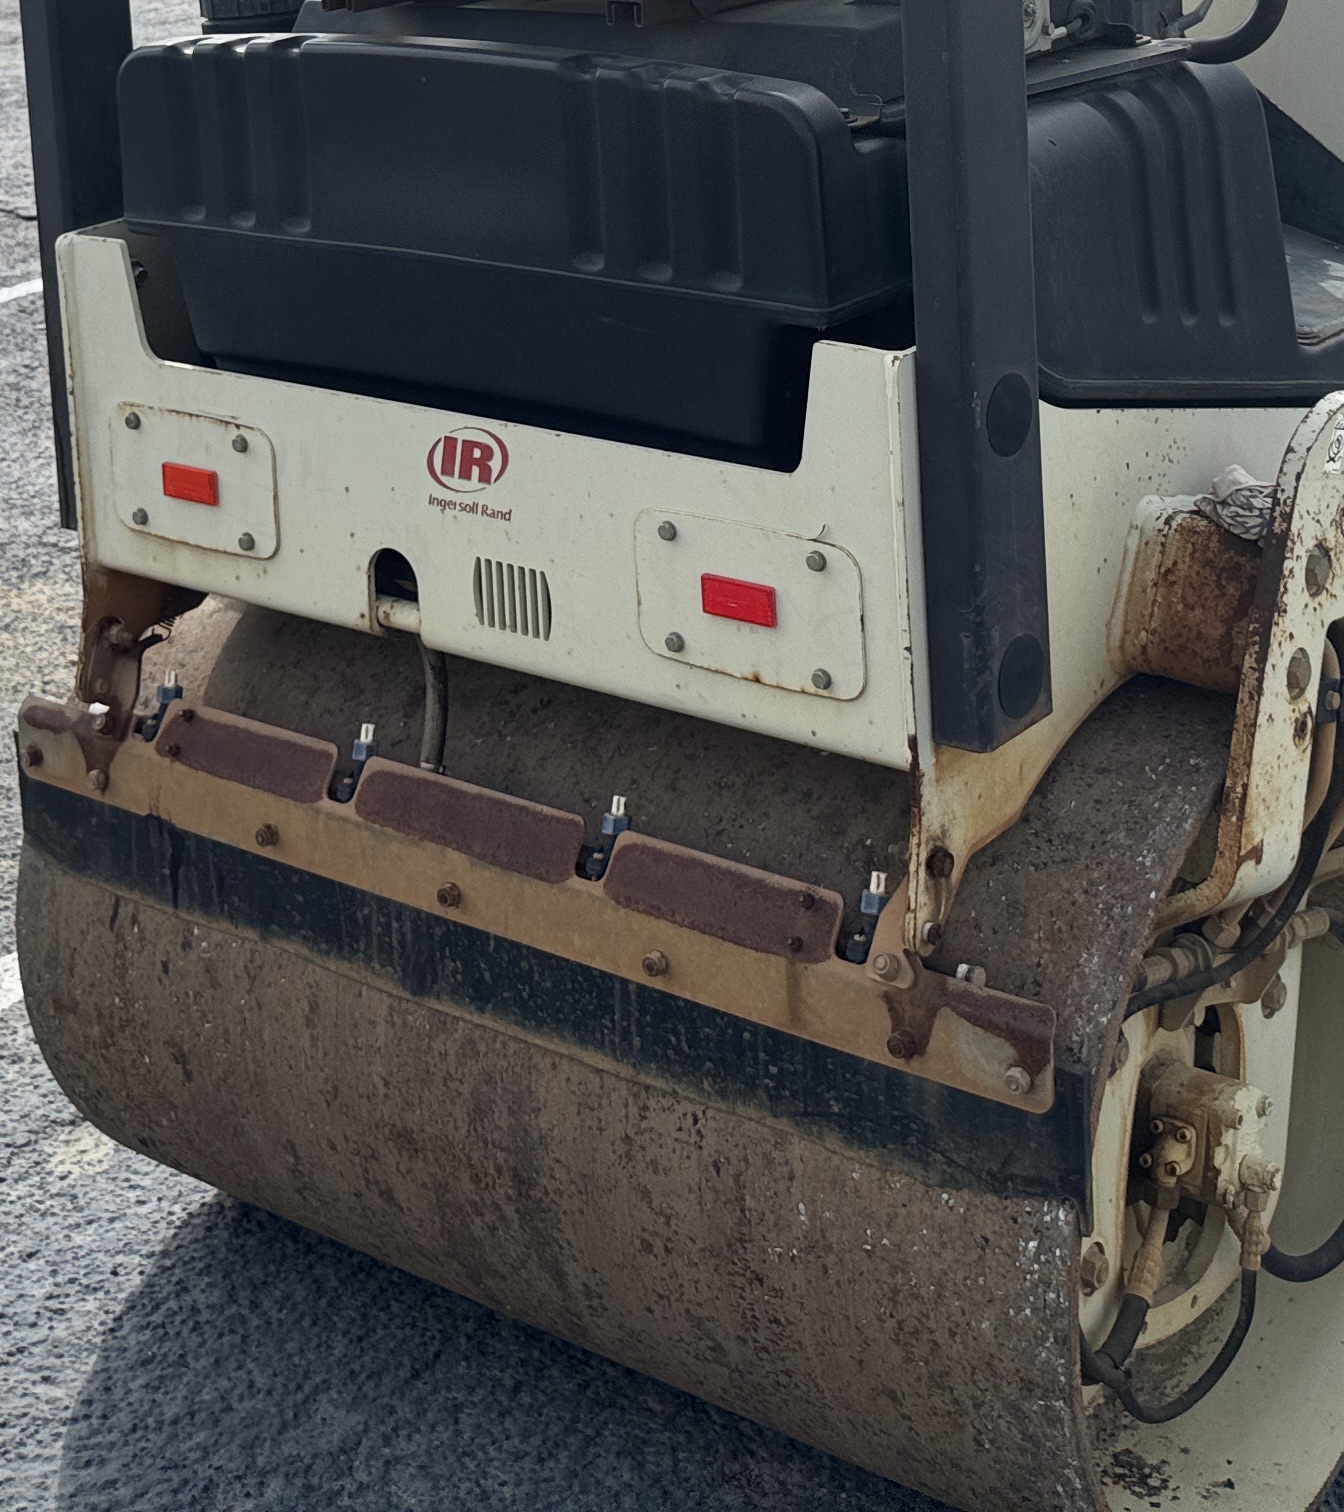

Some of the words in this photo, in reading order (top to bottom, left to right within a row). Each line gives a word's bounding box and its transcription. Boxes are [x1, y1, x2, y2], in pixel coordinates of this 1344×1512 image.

[440, 434, 495, 486] IR
[427, 493, 480, 516] Ingersoll
[480, 504, 513, 522] Rand
